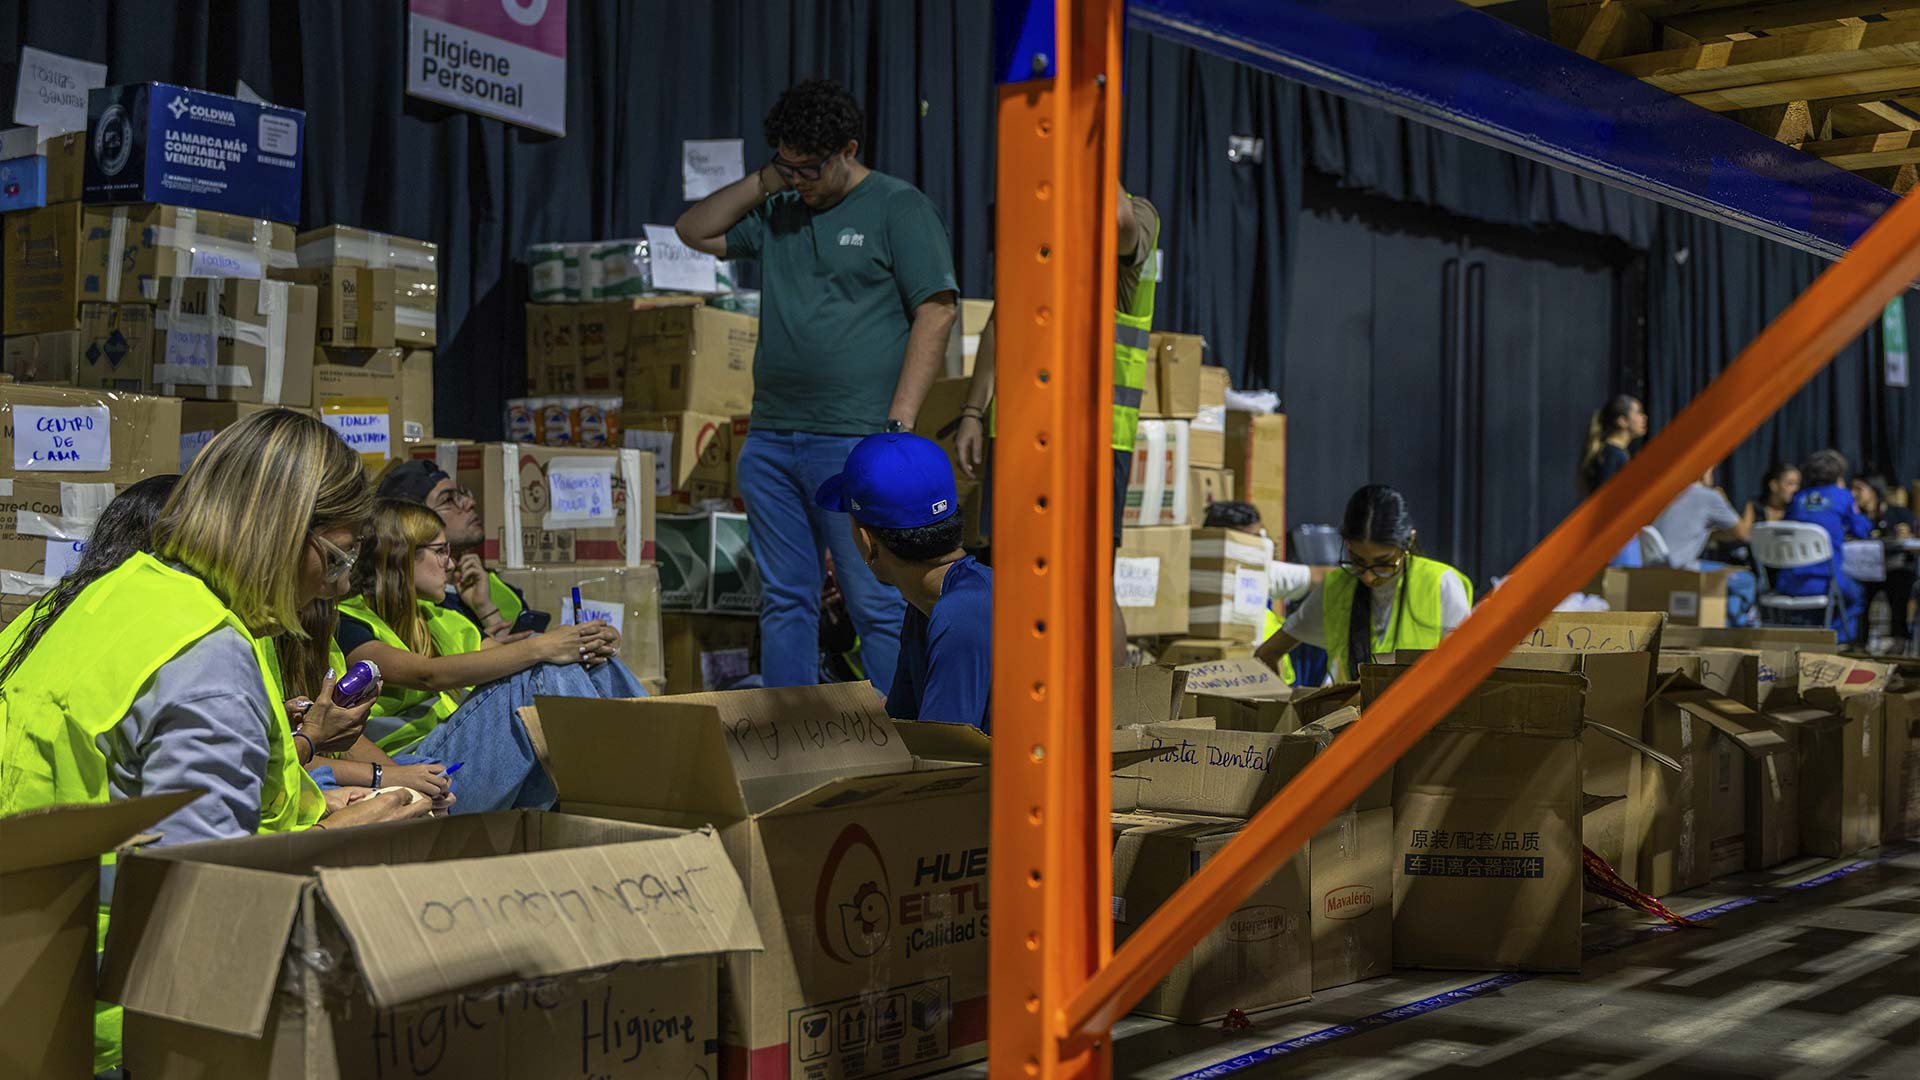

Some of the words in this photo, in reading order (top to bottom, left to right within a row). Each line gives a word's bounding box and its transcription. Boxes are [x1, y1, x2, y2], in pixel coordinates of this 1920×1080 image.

[423, 29, 510, 77] Higiene
[422, 57, 523, 108] Personal
[190, 105, 236, 123] COLDWA
[165, 142, 226, 161] CONFIABLE
[227, 152, 241, 163] EN
[166, 130, 180, 142] LA
[181, 132, 223, 149] MARCA
[224, 139, 248, 153] MÁS
[164, 151, 227, 171] VENEZUELA
[36, 416, 94, 432] CENTRO
[53, 435, 74, 448] DE
[1206, 745, 1274, 774] Dental
[1410, 829, 1540, 851] 原装/配套/品质
[914, 847, 988, 887] HUE
[1409, 855, 1540, 877] 车用离合器部件
[900, 890, 939, 926] EL
[1327, 891, 1371, 913] Mavalério
[906, 917, 975, 959] ¡Calidad
[582, 986, 695, 1074] Higiene
